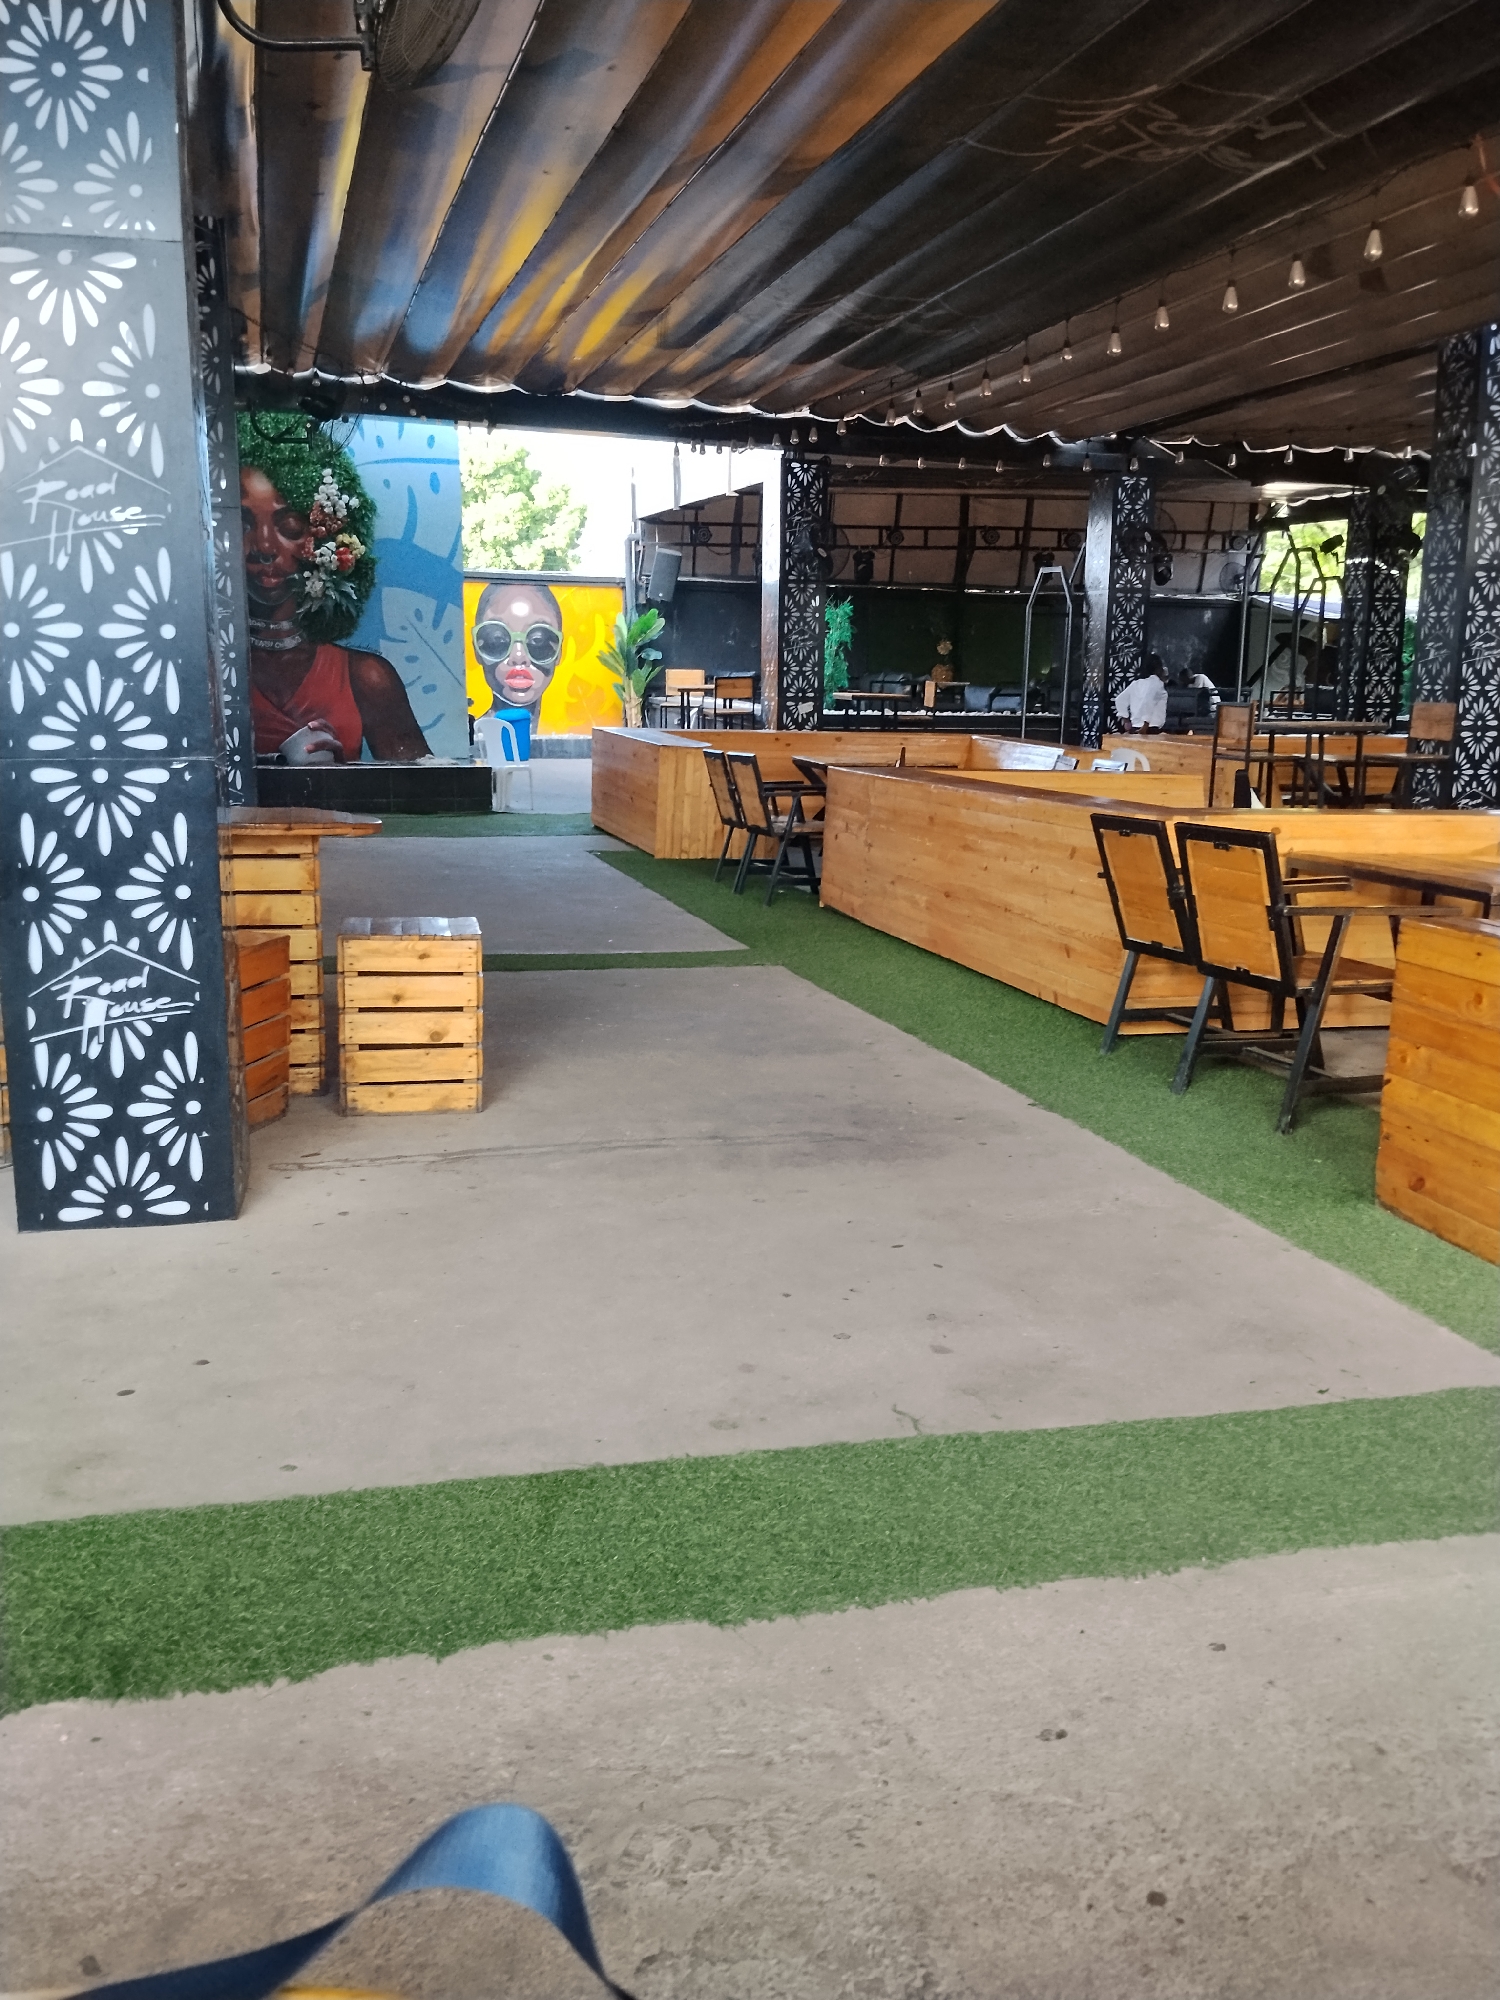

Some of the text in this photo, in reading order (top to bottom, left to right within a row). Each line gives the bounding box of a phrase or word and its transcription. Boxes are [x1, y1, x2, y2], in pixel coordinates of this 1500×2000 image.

[16, 472, 118, 524] Road
[49, 506, 165, 565] House
[50, 966, 150, 1019] Road
[80, 997, 194, 1055] House
